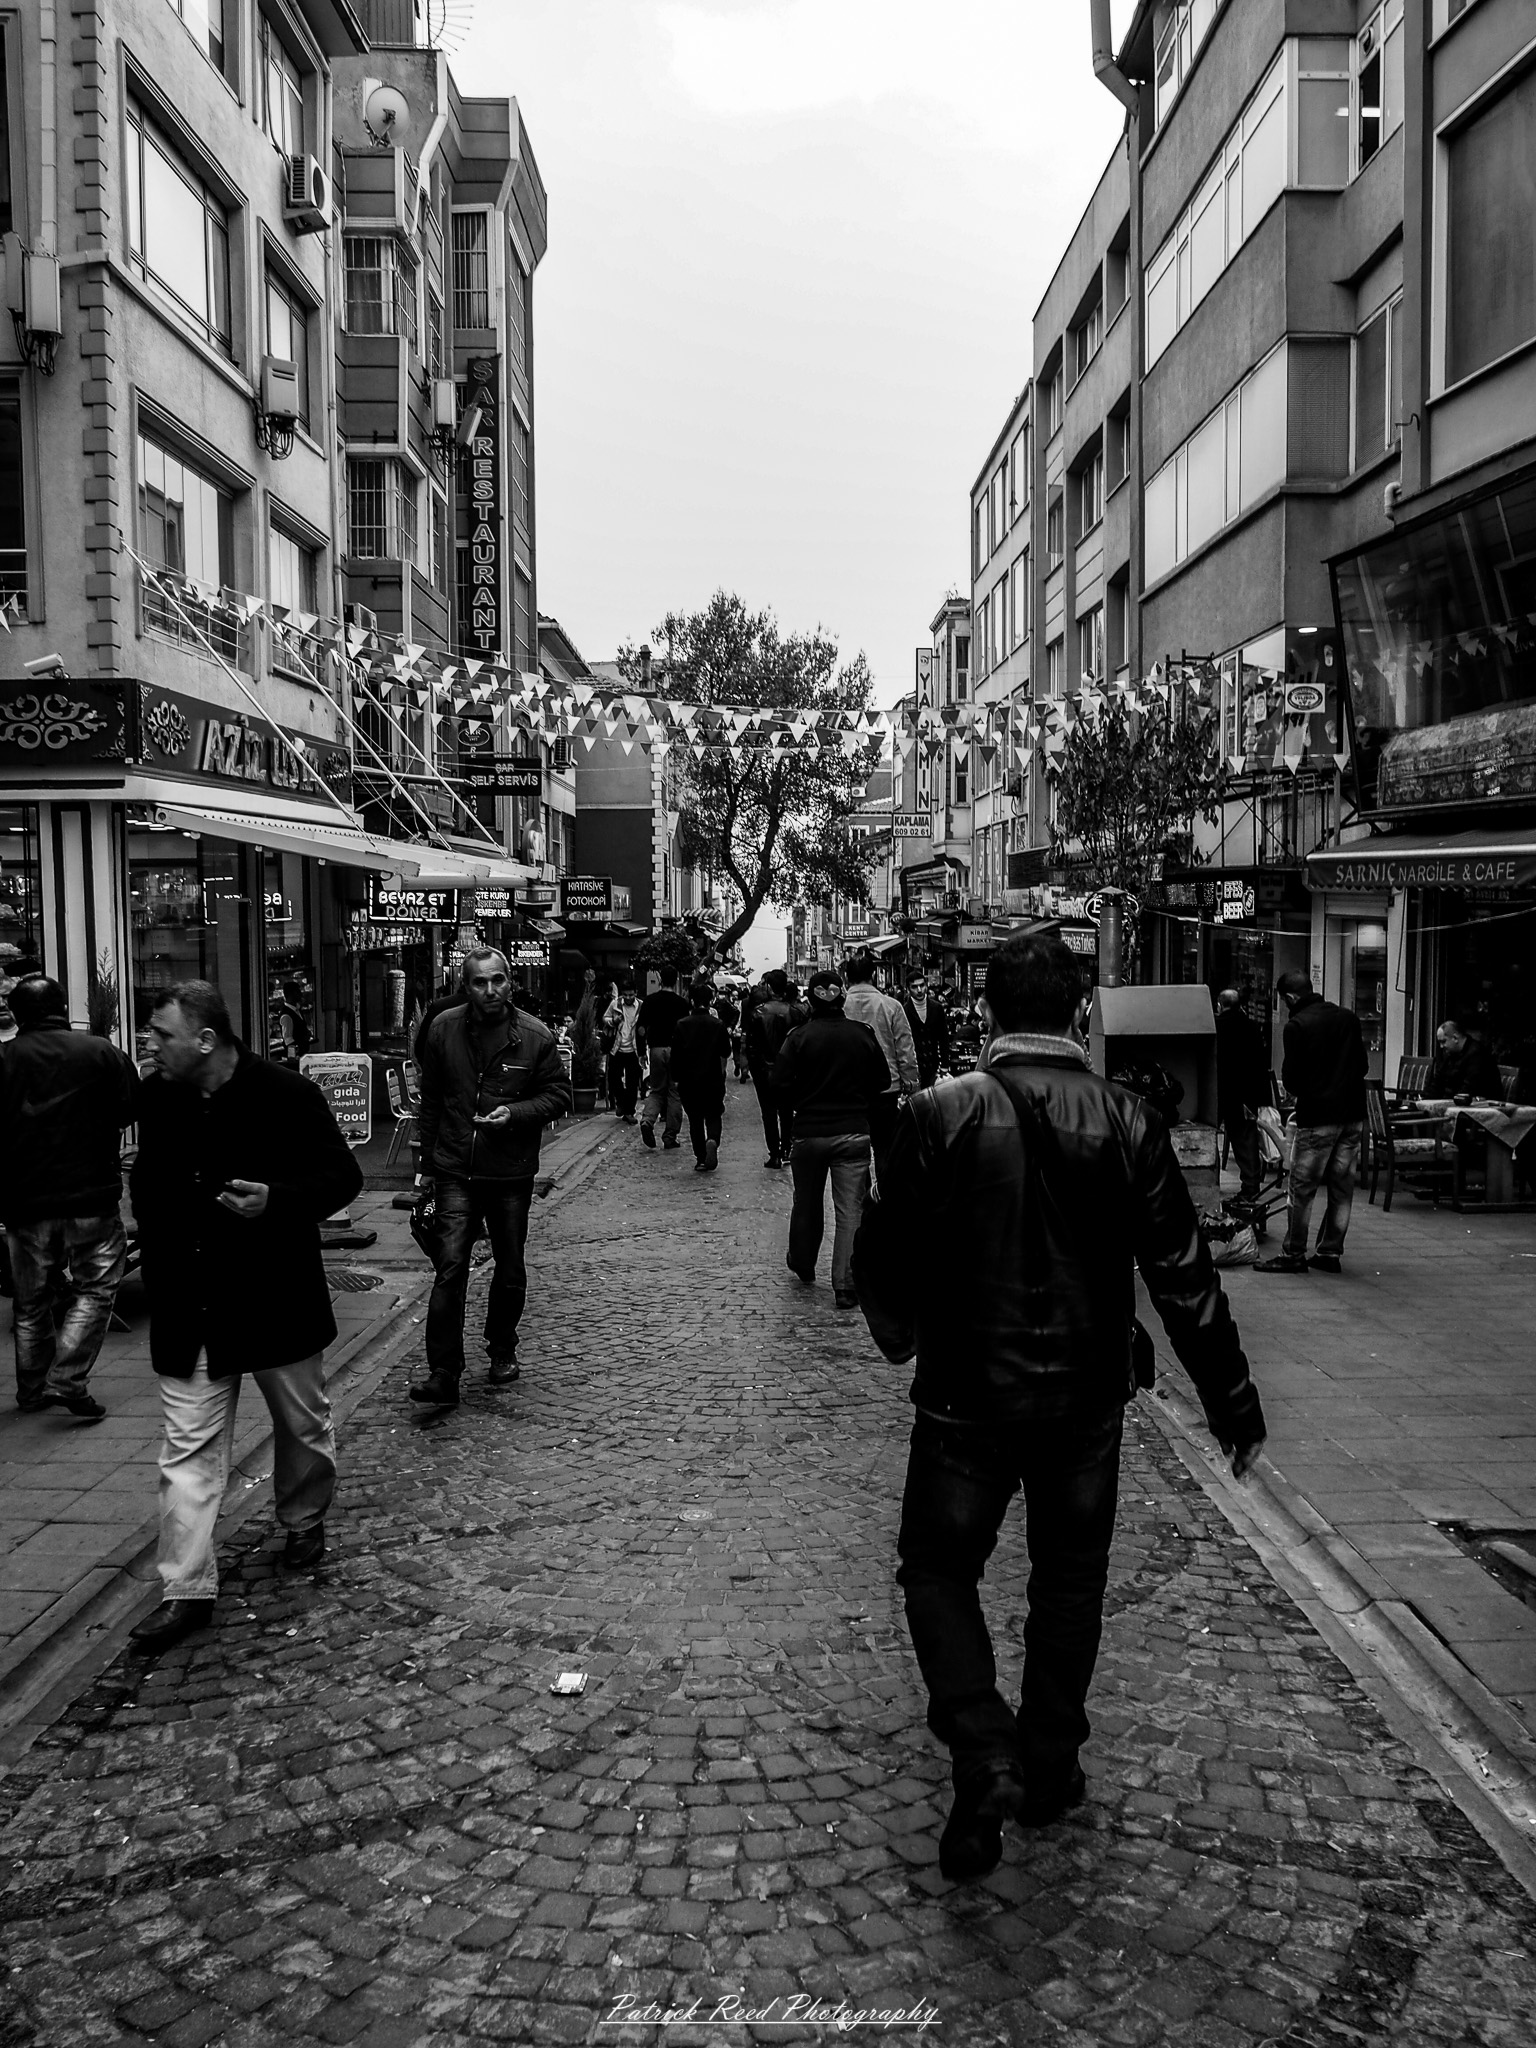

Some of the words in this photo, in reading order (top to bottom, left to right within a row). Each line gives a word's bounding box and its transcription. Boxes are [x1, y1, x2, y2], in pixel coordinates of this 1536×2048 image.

[472, 437, 495, 649] RESTAURANT
[495, 763, 515, 774] ŞAR
[470, 774, 496, 787] SELF
[497, 772, 539, 787] SERVİS
[894, 816, 930, 827] KAPLAMA
[895, 828, 909, 836] 609
[910, 828, 919, 836] 02
[920, 828, 930, 836] 61
[1335, 862, 1397, 885] SARNIÇ
[1399, 861, 1456, 882] NARGİLE
[1462, 864, 1471, 882] &
[1474, 861, 1516, 881] CAFE
[567, 880, 604, 892] KIRTASİYE
[1223, 880, 1243, 899] EFES
[378, 891, 425, 906] BEYAZ
[428, 893, 447, 906] ET
[489, 891, 510, 900] KURU
[566, 894, 606, 906] FOTOKOPİ
[386, 904, 438, 919] DÖNER
[1223, 902, 1244, 920] BEER
[336, 1111, 367, 1122] Food
